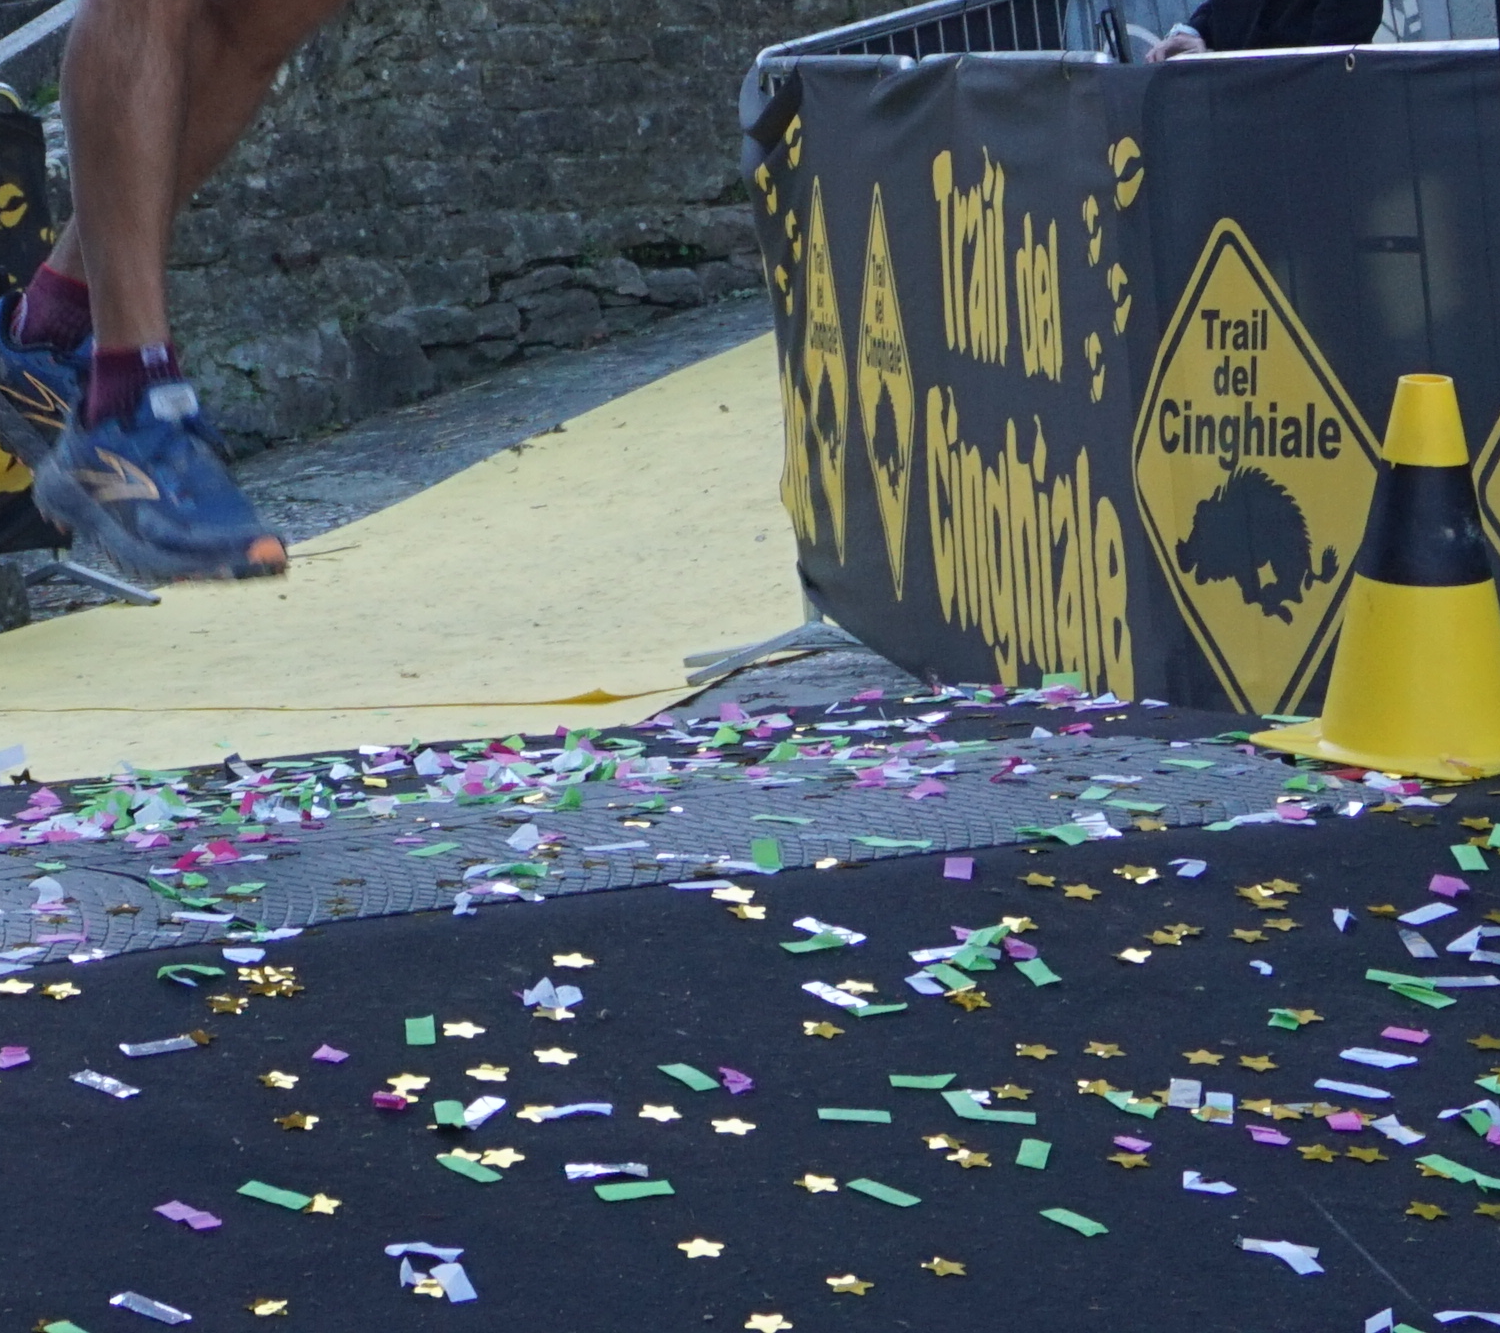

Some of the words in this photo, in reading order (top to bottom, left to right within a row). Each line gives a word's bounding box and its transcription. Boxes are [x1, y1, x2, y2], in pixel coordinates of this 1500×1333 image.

[932, 144, 1007, 367] Trail
[1015, 210, 1063, 382] del
[1201, 308, 1269, 355] Trail
[1212, 354, 1257, 397] del
[1158, 399, 1343, 472] Cinghiale
[926, 384, 1135, 701] Cinghiale
